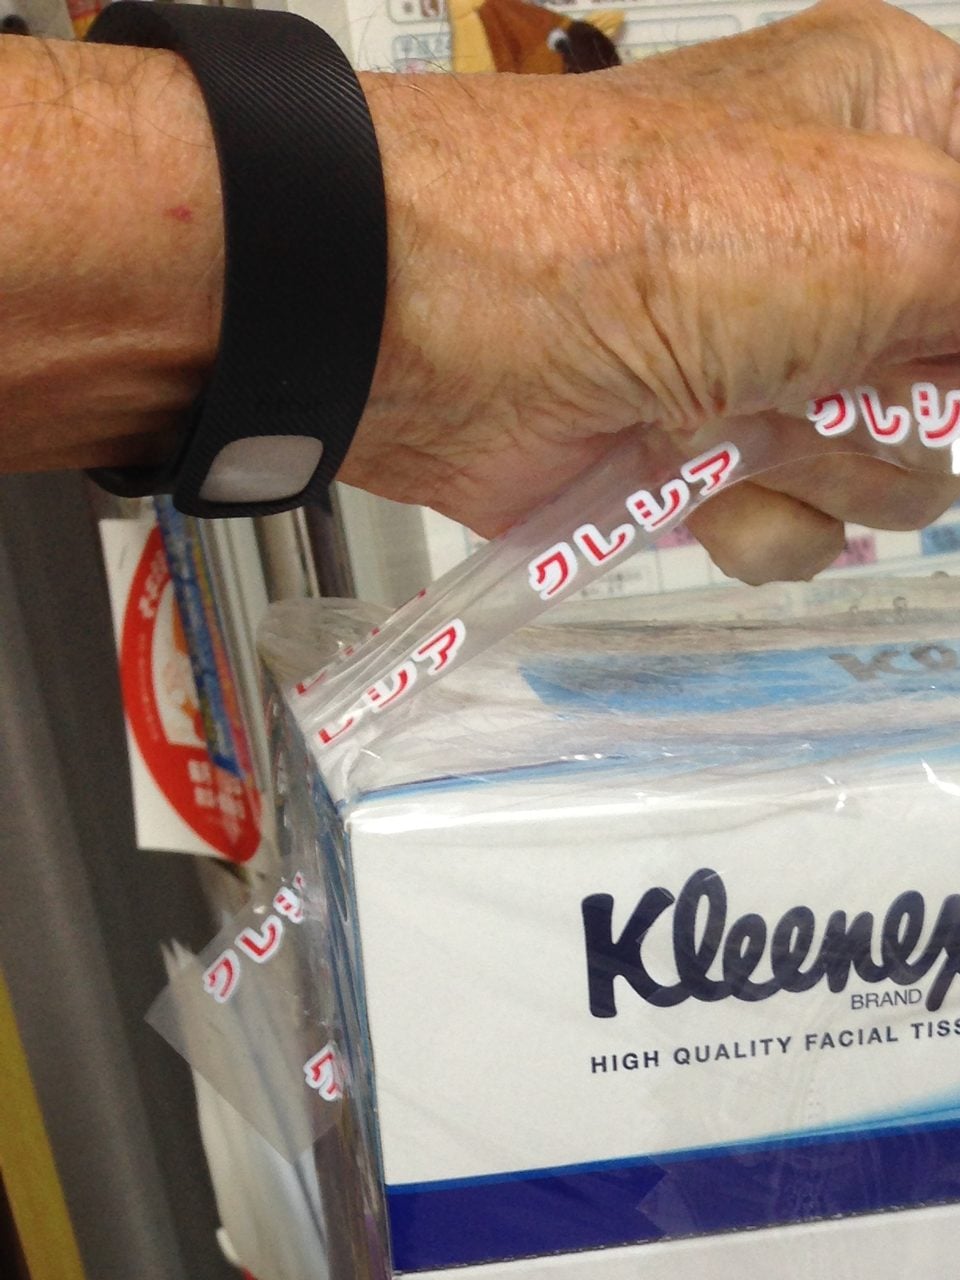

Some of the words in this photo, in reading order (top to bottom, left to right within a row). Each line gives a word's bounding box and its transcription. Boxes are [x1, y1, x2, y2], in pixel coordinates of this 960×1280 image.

[529, 442, 740, 600] クレシア
[852, 989, 923, 1010] BRAND
[591, 1051, 659, 1073] HIGH
[673, 1036, 792, 1064] QUALITY
[806, 1026, 898, 1051] FACIAL
